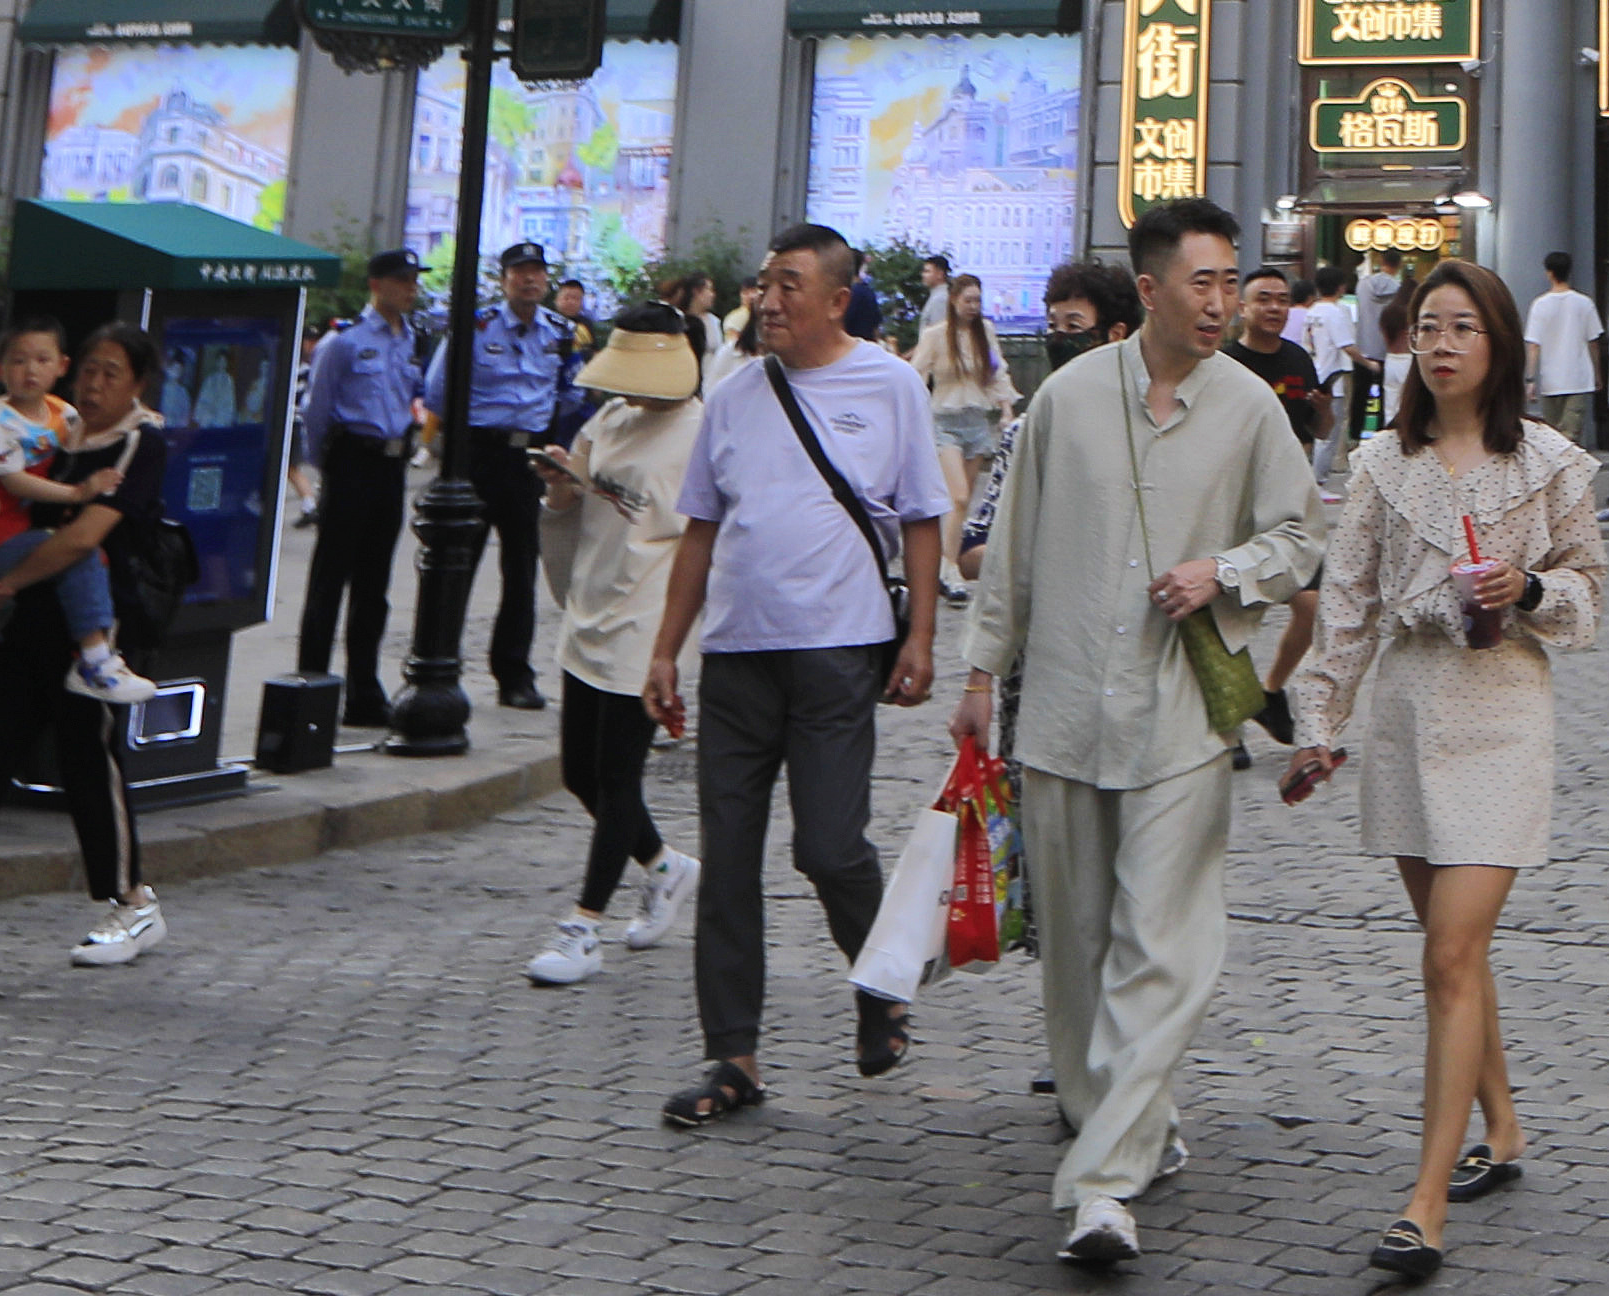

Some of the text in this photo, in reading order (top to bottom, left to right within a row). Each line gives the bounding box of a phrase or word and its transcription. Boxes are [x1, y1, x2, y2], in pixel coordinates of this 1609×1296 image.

[1331, 1, 1444, 42] 文创市集
[1133, 116, 1197, 159] 文创
[1338, 111, 1441, 147] 格瓦斯
[1132, 158, 1195, 201] 市集
